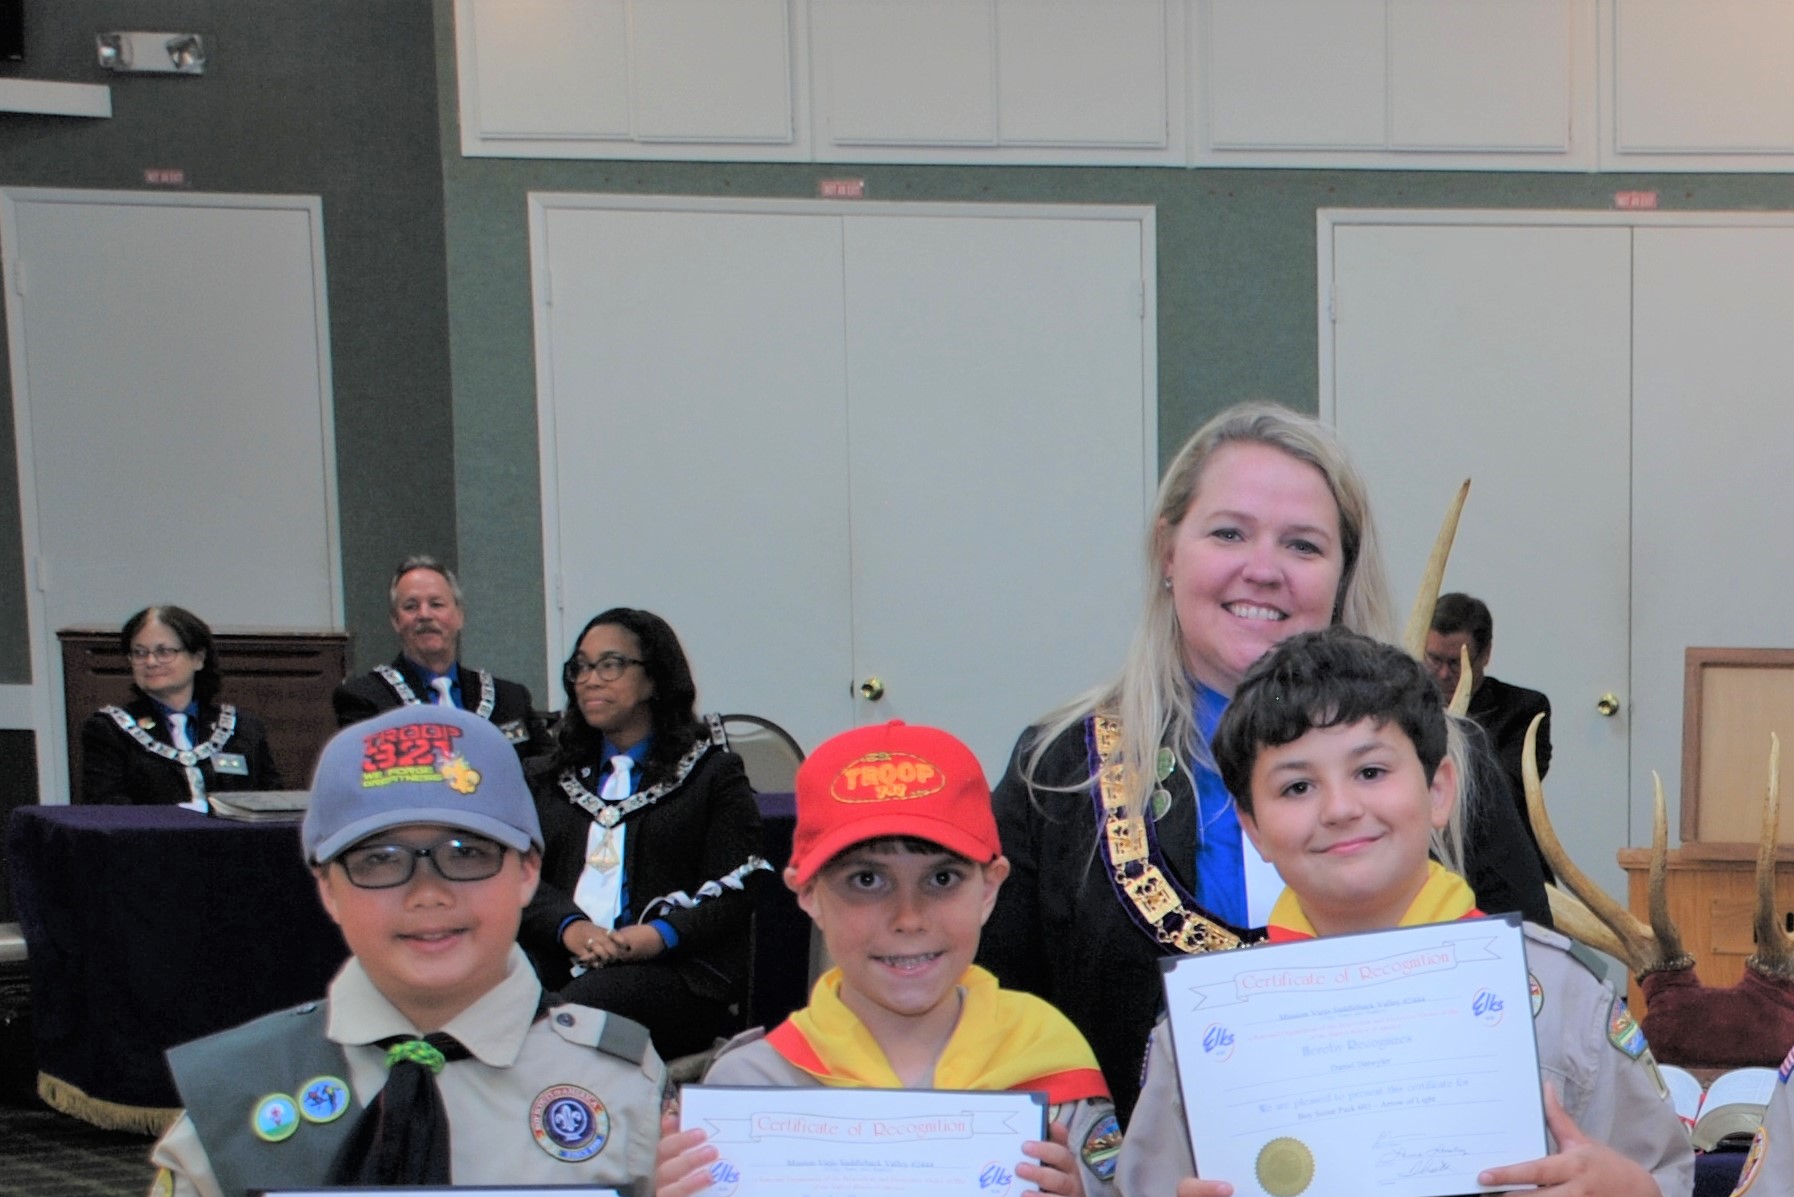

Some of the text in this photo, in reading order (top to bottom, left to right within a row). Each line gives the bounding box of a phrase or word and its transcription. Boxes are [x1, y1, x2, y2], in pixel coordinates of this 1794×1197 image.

[364, 723, 462, 748] TROOP
[845, 762, 934, 790] TROOP
[1241, 953, 1449, 990] Certificate of Recognition
[1473, 990, 1505, 1016] Elks
[1202, 1026, 1234, 1051] Elks
[757, 1116, 965, 1139] Certificate of Recognition
[979, 1164, 1012, 1189] Elks
